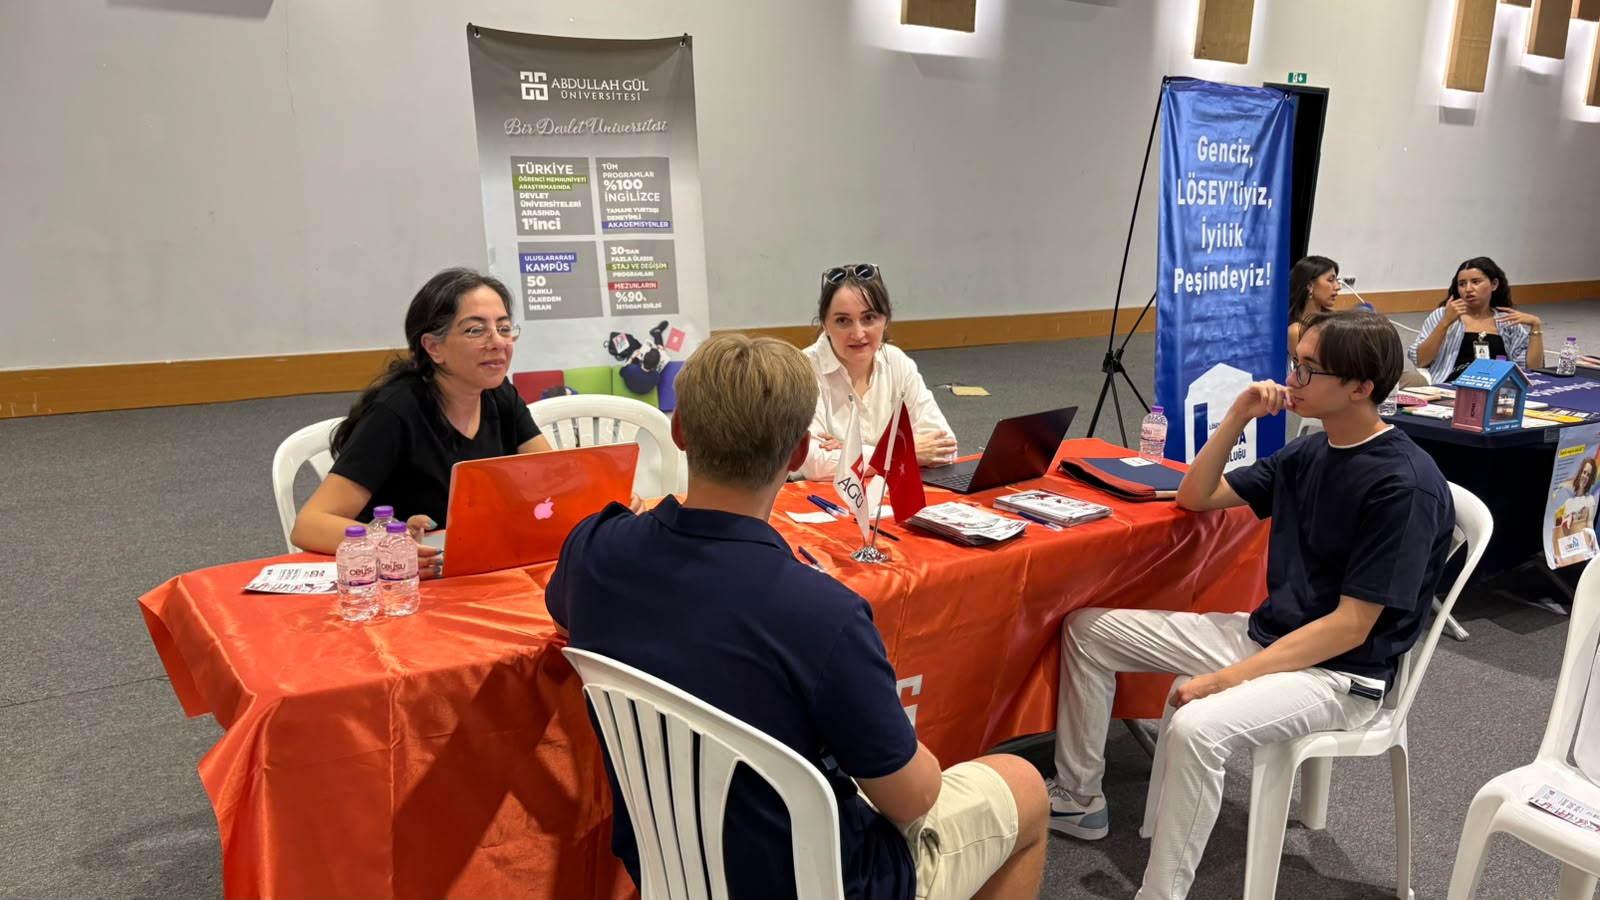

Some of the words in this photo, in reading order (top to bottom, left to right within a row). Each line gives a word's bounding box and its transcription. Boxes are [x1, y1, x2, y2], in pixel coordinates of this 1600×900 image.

[551, 78, 619, 91] ABDULLAH
[622, 78, 649, 92] GÜL
[504, 117, 535, 135] Bir
[536, 117, 584, 135] Devlet
[1197, 135, 1254, 168] Genciz,
[517, 162, 574, 175] TÜRKİYE
[602, 171, 655, 179] PROGRAMLAR
[603, 179, 644, 191] %100
[1177, 172, 1272, 211] LÖSEV'liyiz,
[604, 190, 661, 203] İNGİLİZCE
[520, 200, 582, 208] ÜNİVERSİTELERİ
[521, 209, 561, 217] ARASINDA
[521, 217, 562, 231] 1'inci
[1201, 216, 1244, 254] İyilik
[524, 254, 575, 262] ULUSLARARASI
[525, 261, 570, 272] KAMPÜS
[527, 275, 547, 288] 50
[1174, 262, 1271, 295] Peşindeyiz!
[614, 282, 657, 290] MEZUNLARIN
[528, 295, 562, 303] ÜLKEDEN
[529, 303, 552, 311] İNSAN
